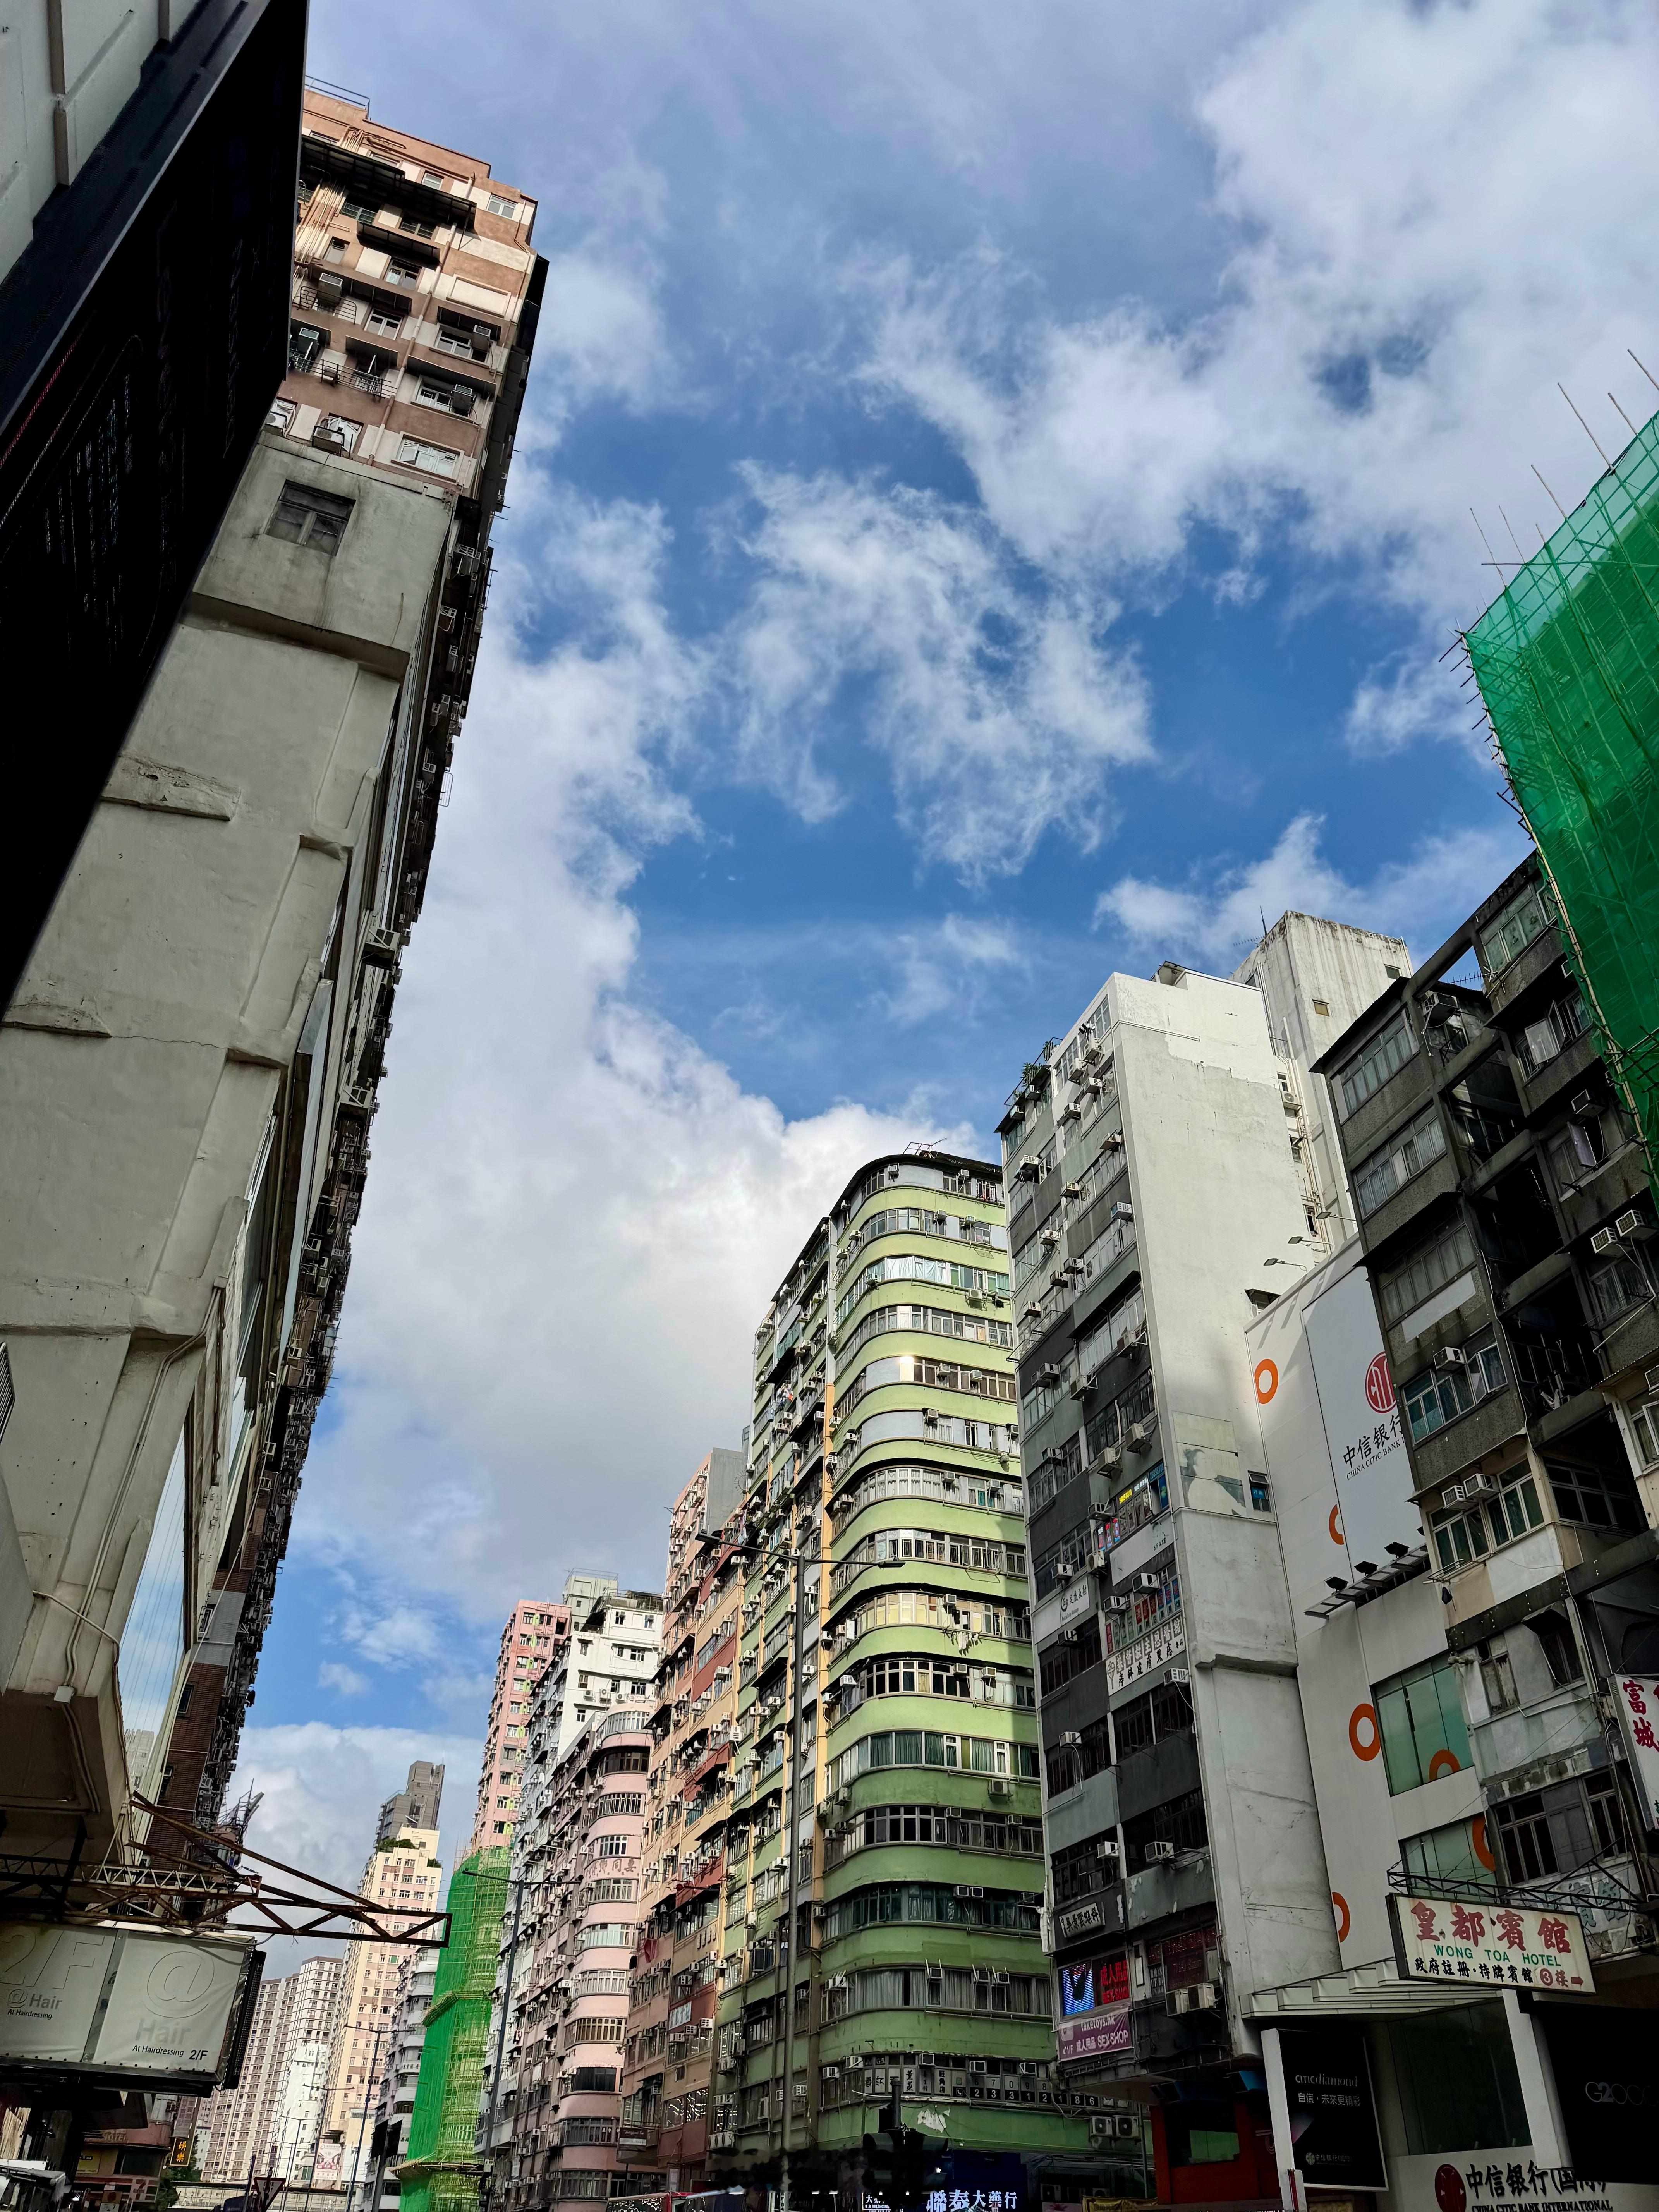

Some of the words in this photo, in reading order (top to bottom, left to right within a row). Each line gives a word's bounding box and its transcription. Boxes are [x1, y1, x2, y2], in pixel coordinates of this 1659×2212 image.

[1346, 1463, 1365, 1480] CHINA
[1365, 1452, 1382, 1467] CITIC
[1382, 1440, 1401, 1456] BANK
[1411, 1901, 1571, 1954] 皇都賓館
[1434, 1944, 1473, 1959] WONG
[1485, 1949, 1510, 1963] TOA
[1523, 1953, 1561, 1967] HOTEL
[29, 1994, 63, 2009] Hair
[16, 2009, 53, 2020] Hairdressing
[135, 2018, 191, 2044] Hair
[142, 2045, 184, 2057] Hairdressing
[189, 2049, 208, 2061] 2/F
[1496, 2204, 1517, 2212] CITIC
[1518, 2202, 1540, 2212] BANK
[1541, 2200, 1613, 2212] INTERNATIONAL
